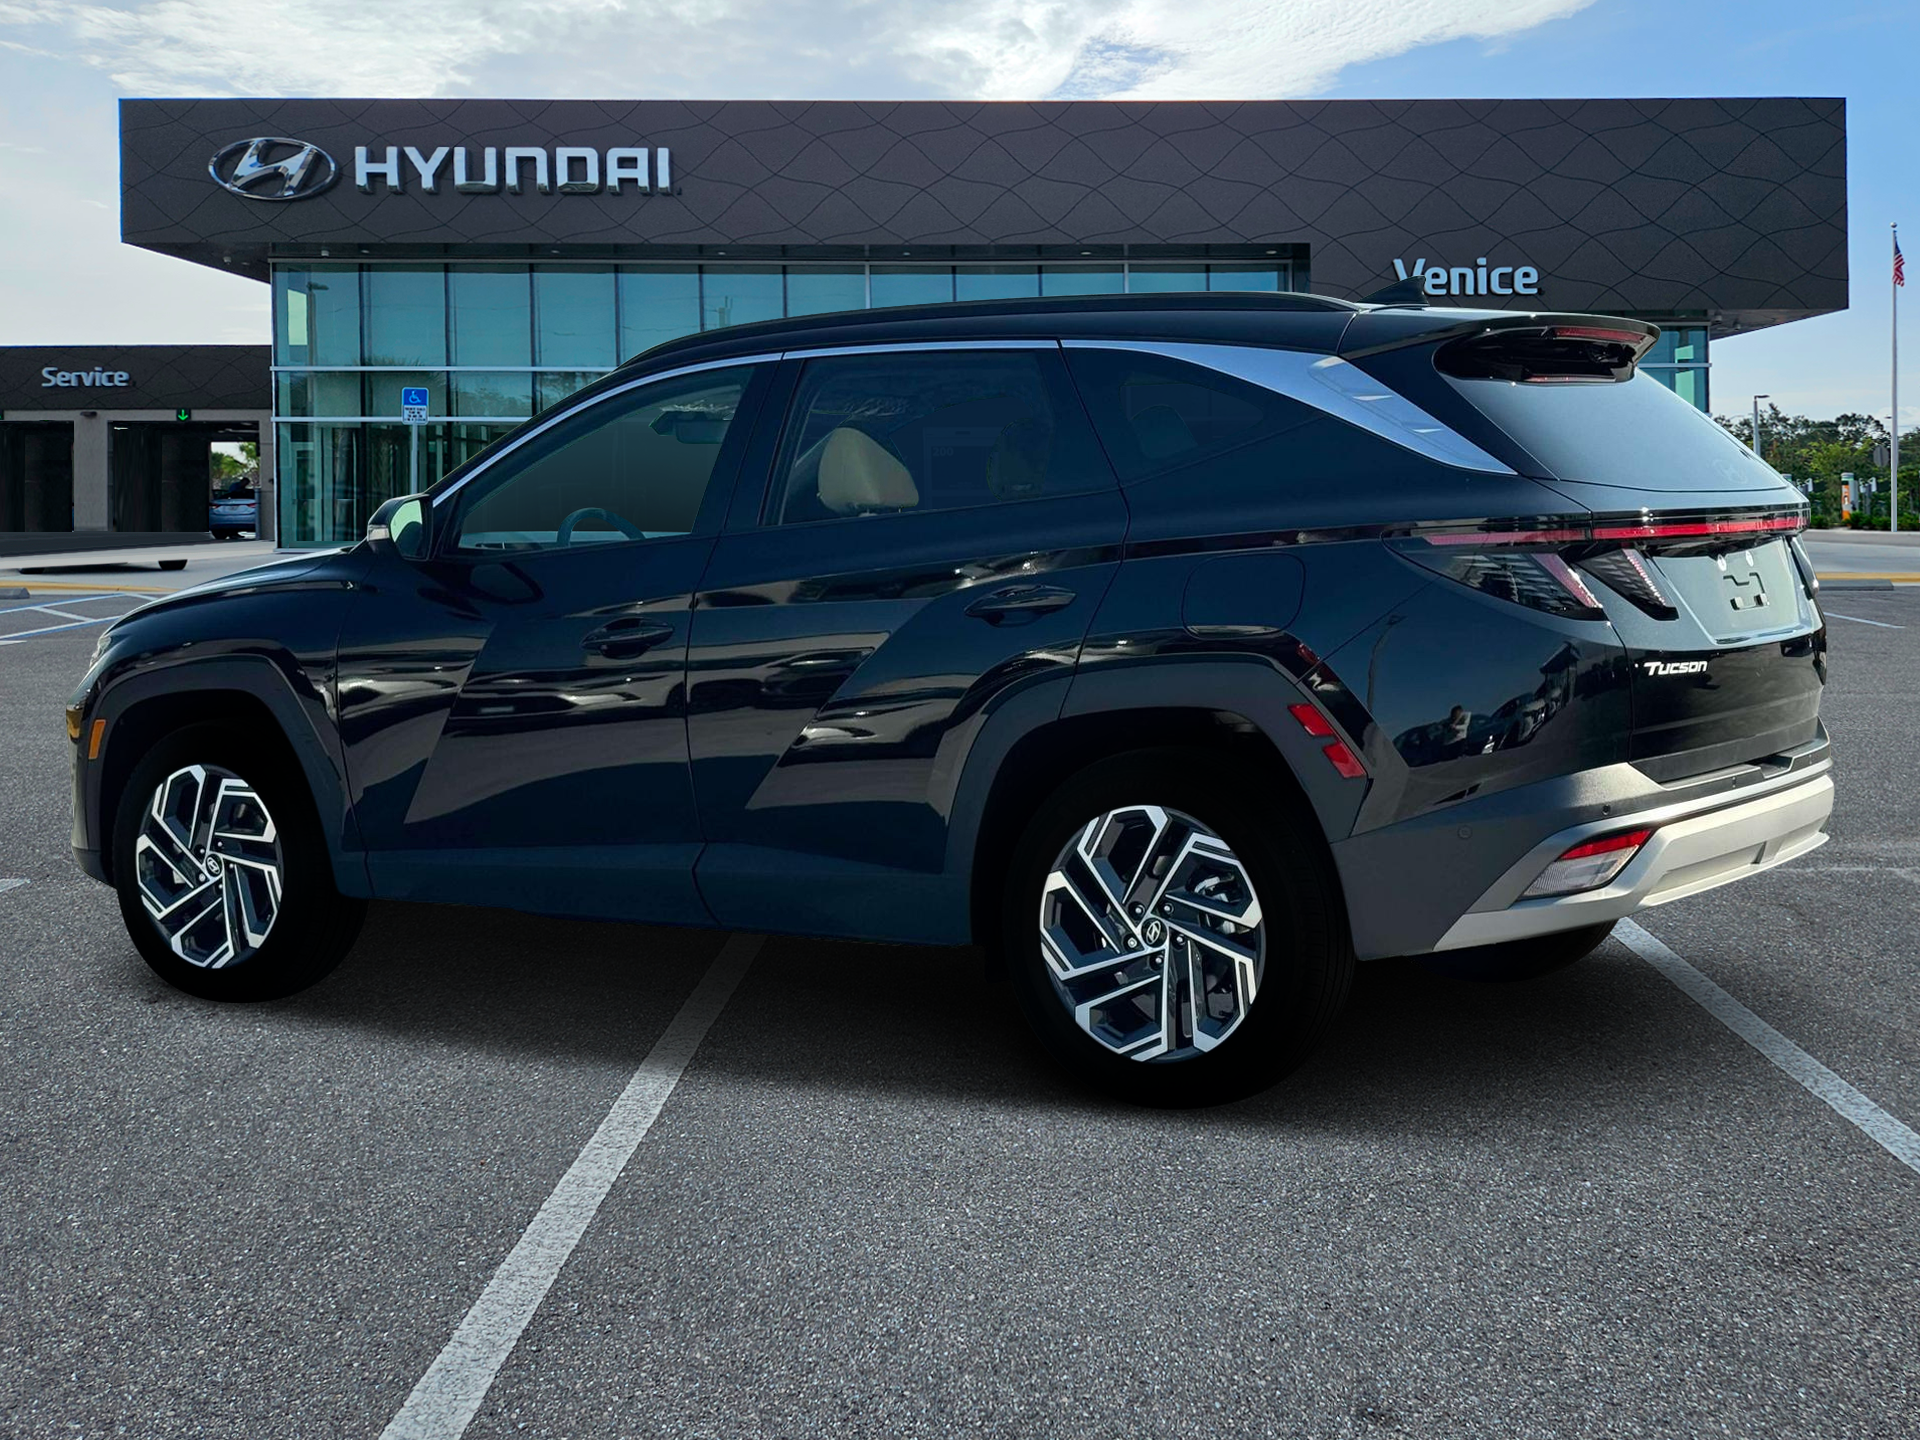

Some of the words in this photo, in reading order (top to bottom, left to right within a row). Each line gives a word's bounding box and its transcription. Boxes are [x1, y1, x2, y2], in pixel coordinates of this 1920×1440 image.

[355, 146, 672, 194] HYUNDAI
[1392, 256, 1539, 296] Venice
[41, 366, 130, 387] Service
[932, 447, 954, 457] 200
